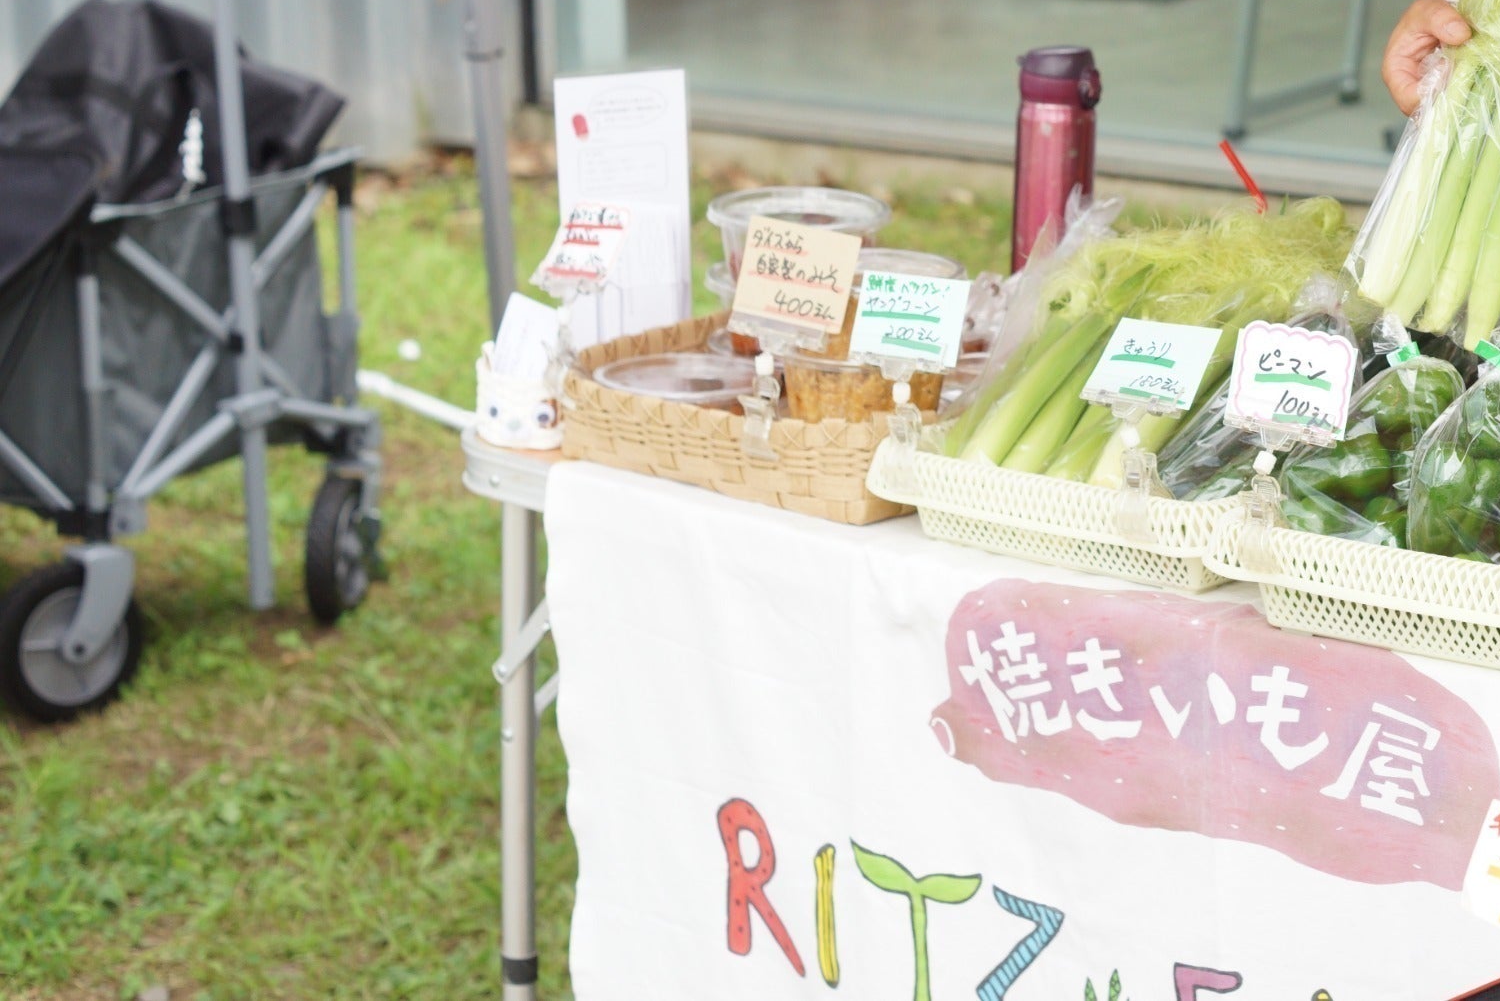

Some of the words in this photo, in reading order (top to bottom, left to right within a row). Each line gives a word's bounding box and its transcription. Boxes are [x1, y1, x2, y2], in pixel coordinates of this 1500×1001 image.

[1123, 338, 1172, 361] きゅうり
[1258, 348, 1327, 381] ピーマン
[959, 620, 1443, 826] 焼きいも屋
